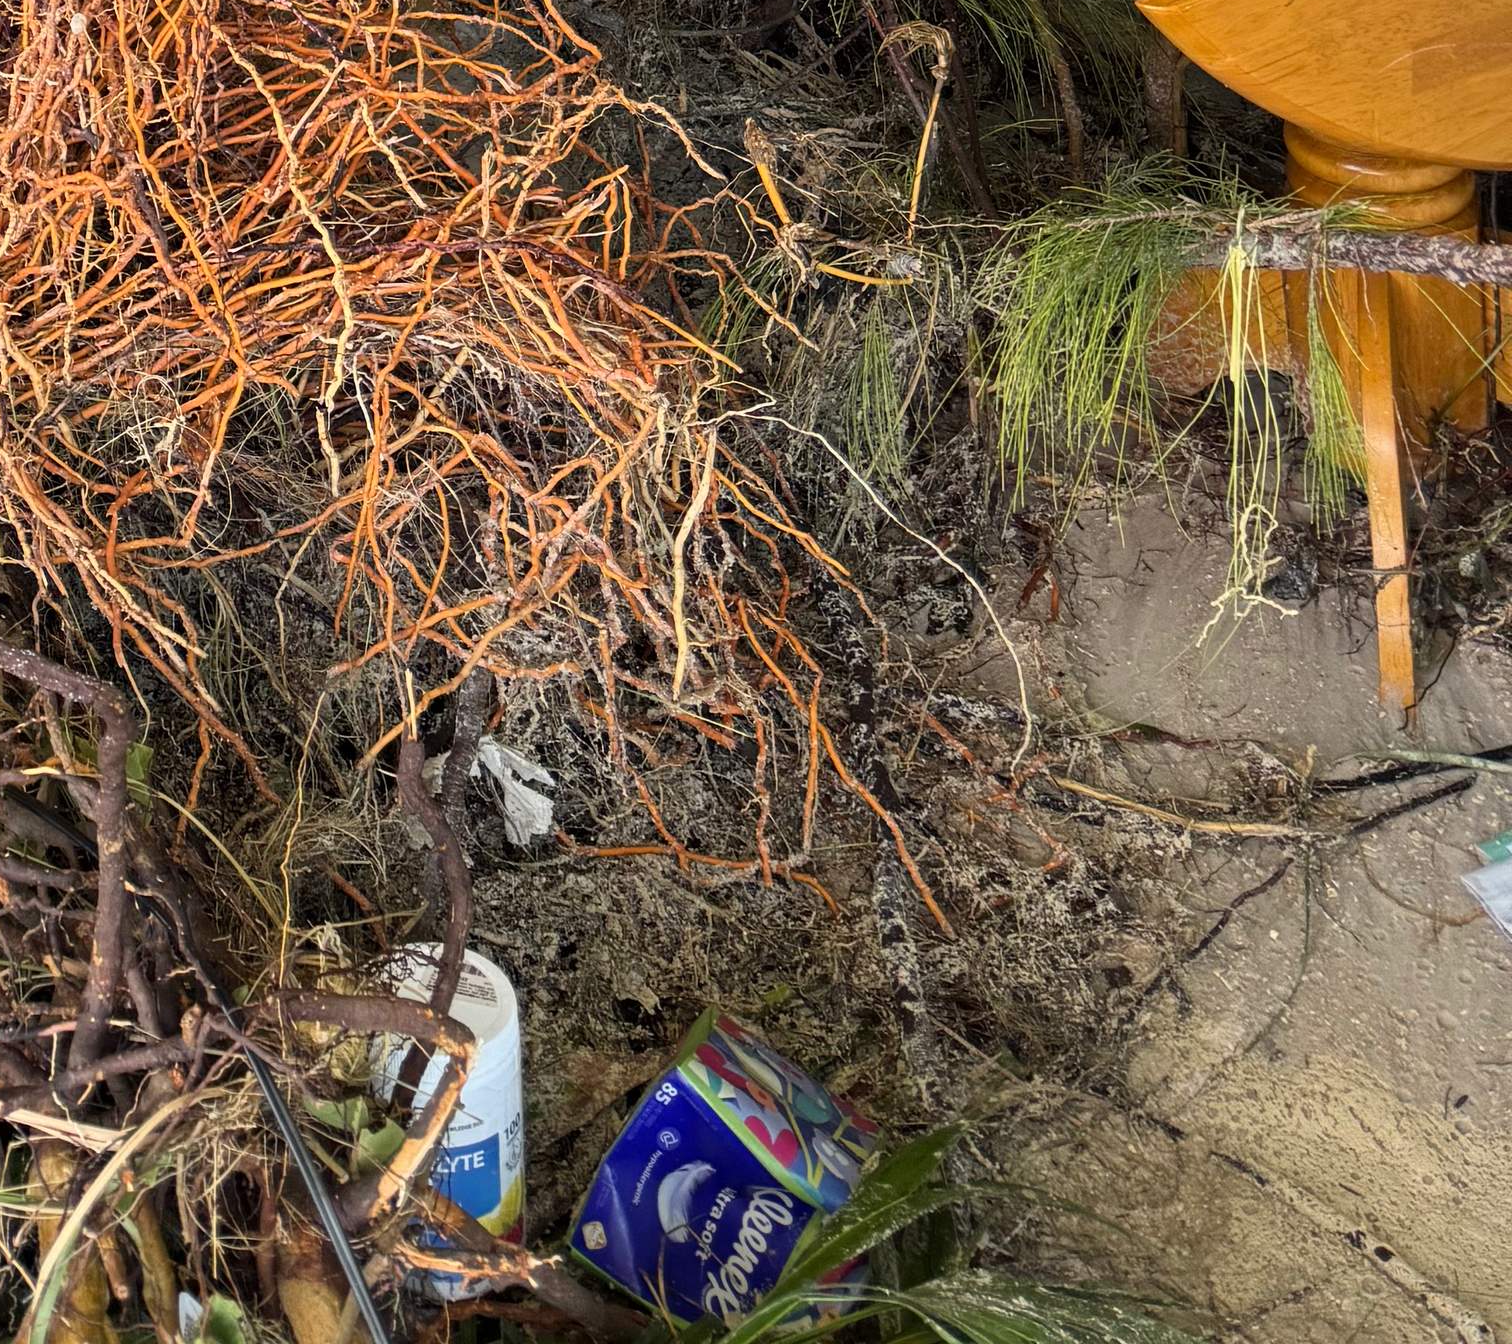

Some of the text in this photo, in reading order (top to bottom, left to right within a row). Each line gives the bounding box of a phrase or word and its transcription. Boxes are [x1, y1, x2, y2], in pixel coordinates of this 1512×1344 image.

[655, 1082, 678, 1106] 85
[503, 1112, 520, 1141] 100
[631, 1150, 663, 1207] hypoallergenic
[695, 1222, 718, 1261] soft
